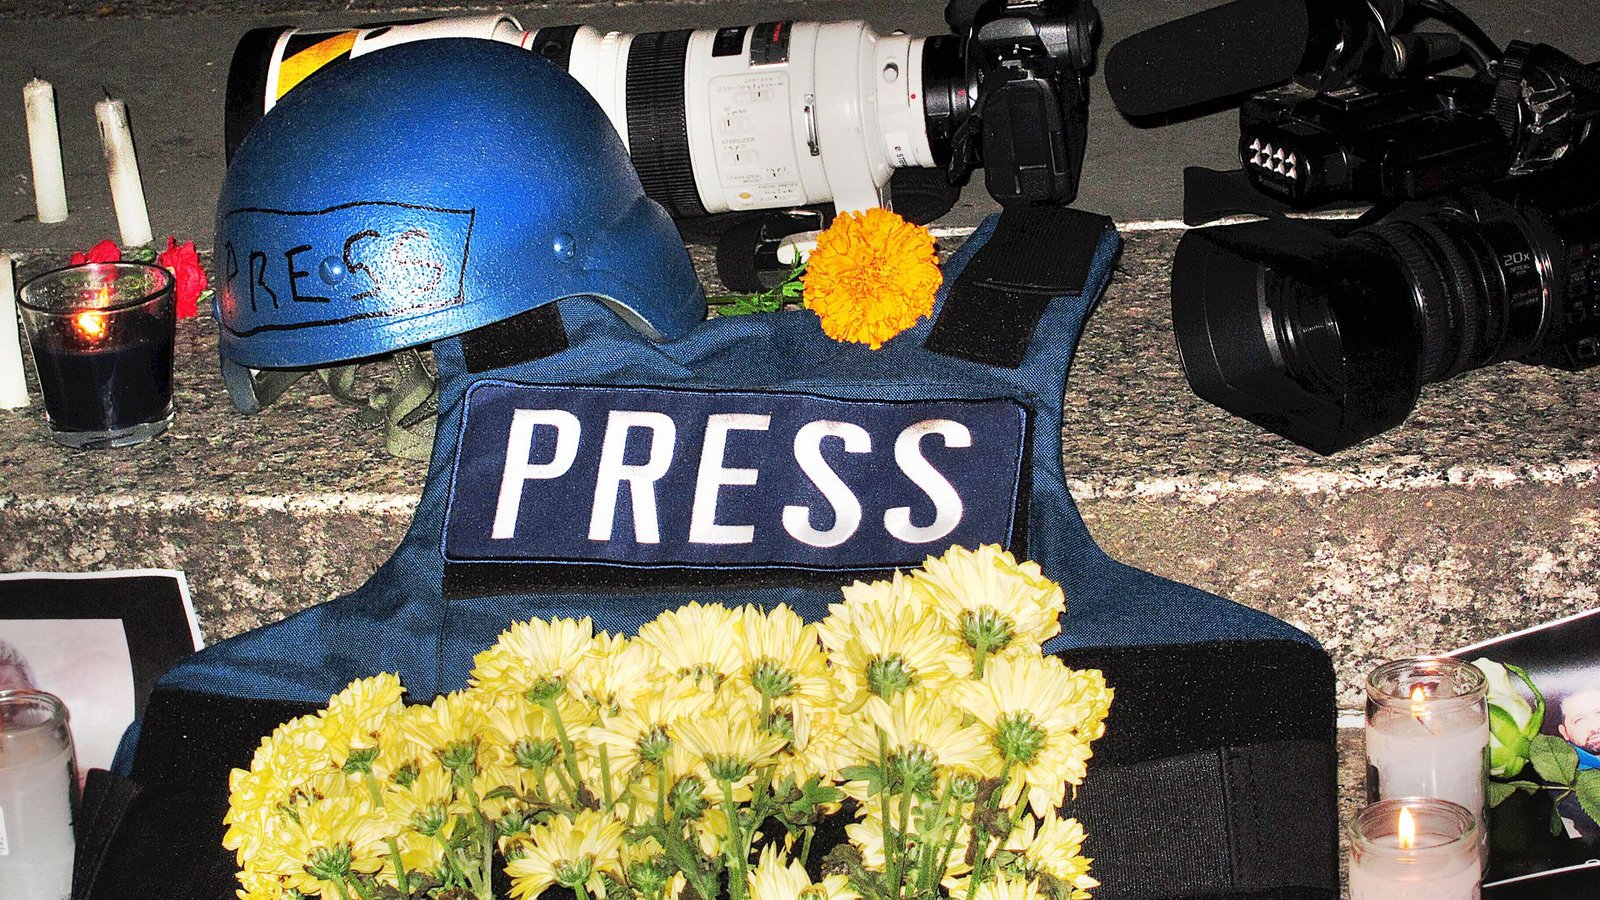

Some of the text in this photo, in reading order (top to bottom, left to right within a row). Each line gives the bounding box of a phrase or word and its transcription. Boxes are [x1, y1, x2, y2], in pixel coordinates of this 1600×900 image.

[225, 229, 443, 315] PRESS
[1503, 251, 1531, 267] 20x
[491, 408, 972, 548] PRESS
